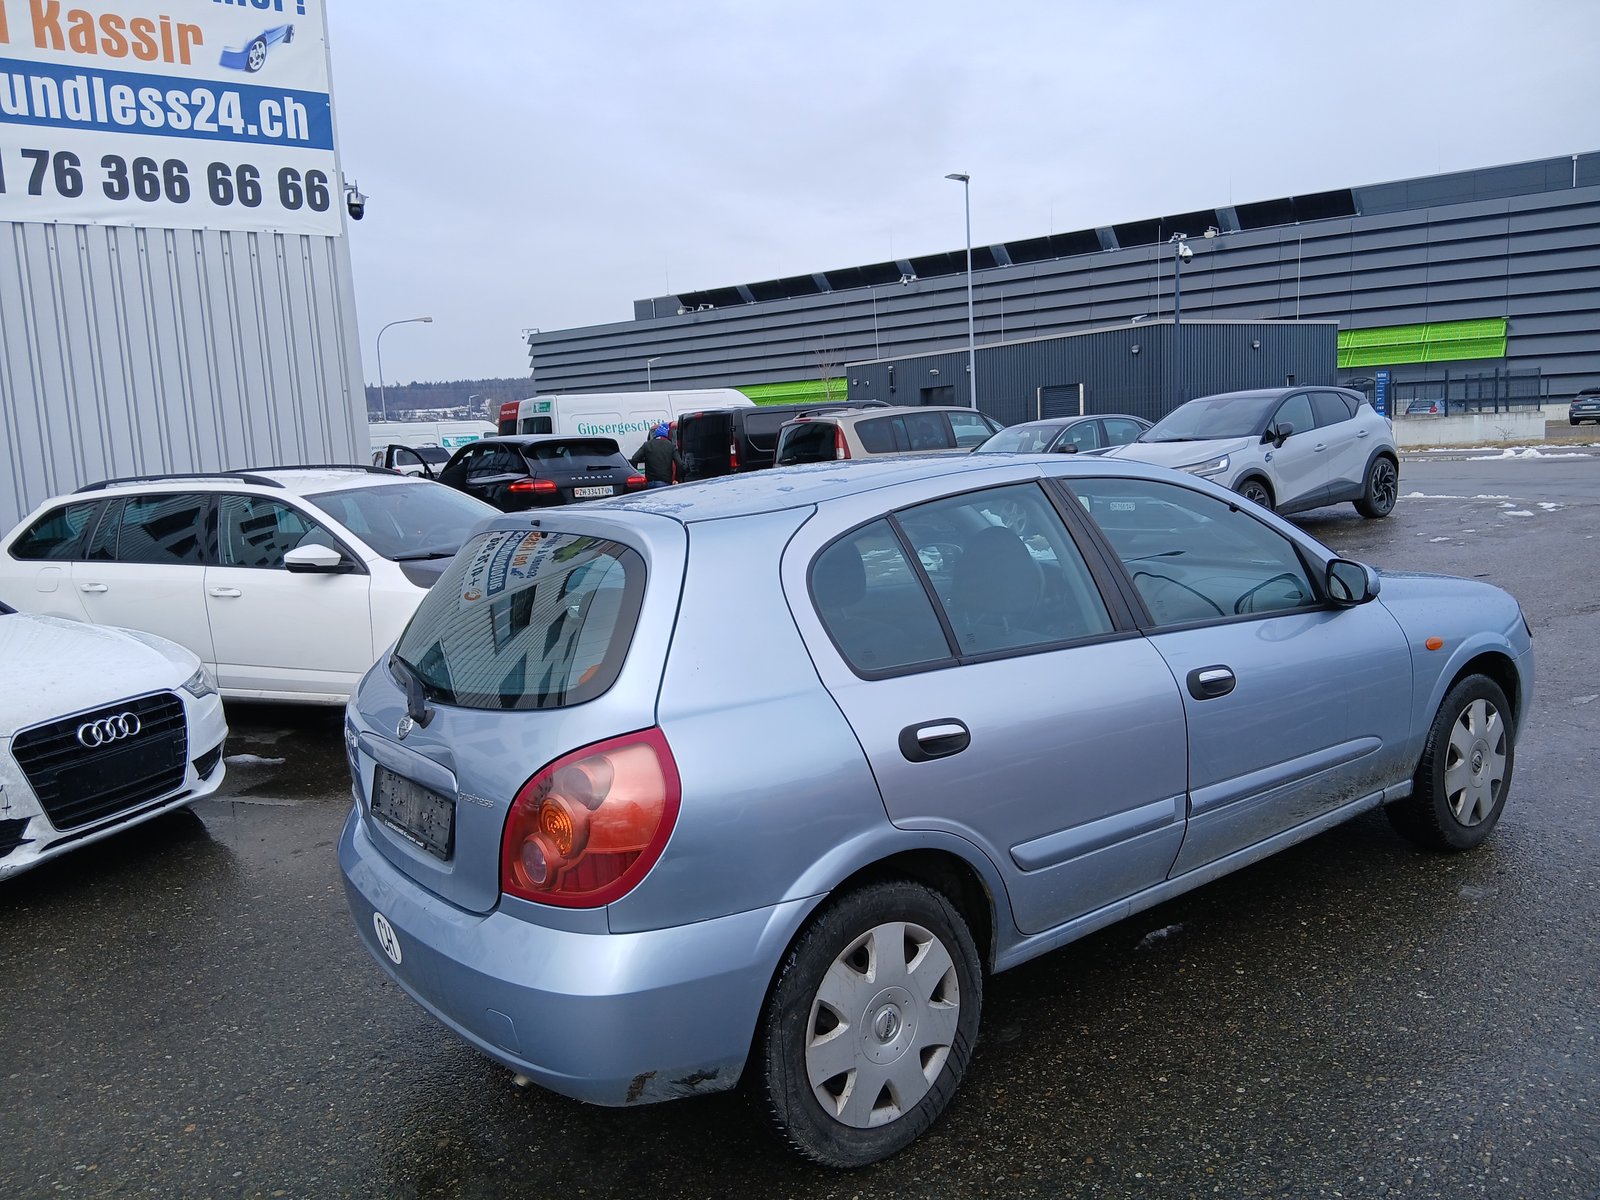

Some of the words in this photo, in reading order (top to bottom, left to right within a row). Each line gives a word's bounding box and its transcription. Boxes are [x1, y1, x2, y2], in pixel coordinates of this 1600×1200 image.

[29, 0, 204, 65] Kassir
[0, 72, 309, 140] undless24.ch
[20, 148, 84, 198] 76
[100, 154, 190, 204] 366
[206, 161, 263, 208] 66
[277, 166, 330, 212] 66
[377, 917, 398, 960] CH
